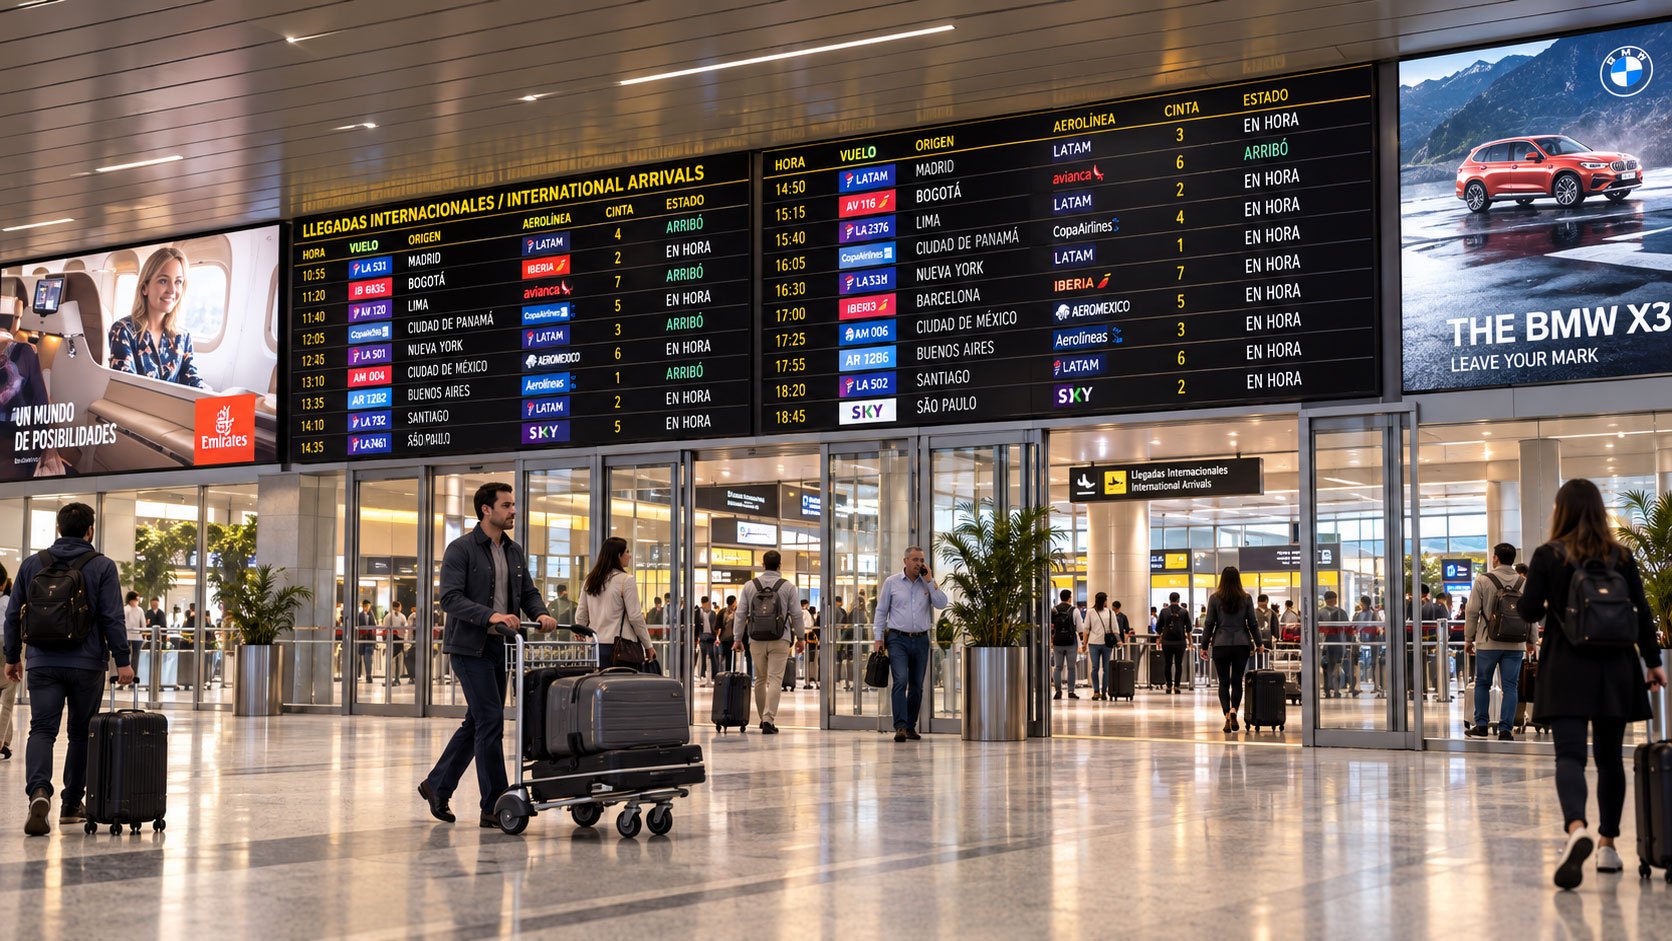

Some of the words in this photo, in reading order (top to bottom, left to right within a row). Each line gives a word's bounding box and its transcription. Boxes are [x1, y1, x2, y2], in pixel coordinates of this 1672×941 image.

[776, 156, 805, 170] HORA
[840, 146, 876, 161] VUELO
[916, 136, 953, 151] ORIGEN
[1165, 101, 1199, 116] CINTA
[1244, 89, 1288, 106] ESTADO
[777, 180, 805, 195] 14:50
[856, 171, 888, 185] LATAM
[916, 160, 954, 176] MADRID
[1054, 141, 1091, 157] LATAM
[1177, 128, 1183, 141] 3
[1245, 117, 1259, 132] EN
[1265, 112, 1299, 129] HORA
[303, 215, 367, 238] LLEGADAS
[370, 195, 494, 227] INTERNACIONALES
[498, 194, 503, 209] /
[508, 177, 624, 207] INTERNATIONAL
[628, 165, 704, 190] ARRIVALS
[776, 206, 805, 220] 15:15
[917, 181, 961, 202] BOGOTÁ
[1053, 171, 1091, 184] avianca
[1177, 155, 1184, 169] 6
[1244, 138, 1288, 160] ARRIBÓ
[776, 231, 805, 246] 15:40
[917, 214, 940, 229] LIMA
[1055, 195, 1091, 210] LATAM
[1177, 183, 1183, 196] 2
[1245, 173, 1260, 188] EN
[1266, 168, 1299, 185] HORA
[303, 248, 325, 259] HORA
[350, 240, 378, 253] VUELO
[408, 231, 441, 245] ORIGEN
[606, 204, 633, 217] CINTA
[667, 195, 704, 209] ESTADO
[303, 268, 325, 281] 10:55
[409, 252, 440, 267] MADRID
[536, 237, 563, 250] LATAM
[615, 228, 621, 239] 4
[666, 213, 703, 233] ARRIBÓ
[776, 257, 805, 271] 16:05
[917, 238, 954, 255] CIUDAD
[959, 236, 971, 249] DE
[976, 227, 1019, 247] PANAMÁ
[1054, 221, 1112, 238] CopaAirlines
[1176, 210, 1184, 223] 4
[1245, 201, 1260, 216] EN
[1266, 197, 1300, 214] HORA
[303, 290, 325, 302] 11:20
[409, 271, 445, 289] BOGOTÁ
[528, 262, 554, 273] IBERIA
[615, 252, 621, 264] 2
[667, 245, 679, 257] EN
[683, 241, 711, 255] HORA
[776, 282, 805, 296] 16:30
[917, 265, 951, 281] NUEVA
[955, 261, 983, 276] YORK
[1055, 249, 1093, 264] LATAM
[1178, 238, 1182, 252] 1
[1246, 230, 1260, 244] EN
[1266, 225, 1300, 242] HORA
[776, 307, 805, 322] 17:00
[917, 288, 980, 307] BARCELONA
[1055, 277, 1094, 291] IBERIA
[1177, 266, 1184, 280] 7
[1246, 258, 1261, 273] EN
[1267, 254, 1300, 271] HORA
[303, 311, 325, 323] 11:40
[409, 299, 428, 311] LIMA
[524, 286, 560, 298] avianca
[615, 276, 621, 287] 7
[666, 263, 703, 282] ARRIBÓ
[303, 333, 324, 345] 12:05
[408, 320, 439, 333] CIUDAD
[442, 318, 453, 330] DE
[457, 311, 493, 328] PANAMÁ
[615, 299, 620, 311] 5
[667, 294, 679, 306] EN
[683, 290, 711, 304] HORA
[776, 333, 805, 347] 17:25
[855, 328, 868, 338] AM
[871, 326, 888, 337] 006
[917, 318, 954, 333] CIUDAD
[959, 315, 972, 329] DE
[977, 310, 1016, 327] MÉXICO
[1072, 300, 1130, 317] AEROMEXICO
[1178, 294, 1184, 308] 5
[1246, 287, 1261, 302] EN
[1267, 283, 1300, 299] HORA
[408, 343, 436, 355] NUEVA
[440, 340, 463, 352] YORK
[536, 330, 563, 342] LATAM
[615, 324, 620, 335] 3
[666, 312, 703, 330] ARRIBÓ
[776, 358, 805, 372] 17:55
[846, 355, 860, 366] AR
[917, 344, 959, 360] BUENOS
[964, 341, 994, 355] AIRES
[1178, 322, 1184, 336] 3
[1247, 316, 1261, 331] EN
[1267, 312, 1301, 329] HORA
[1447, 315, 1515, 347] THE
[1526, 305, 1617, 342] BMW
[1627, 302, 1671, 334] X3
[303, 376, 324, 387] 13:10
[408, 365, 438, 378] CIUDAD
[442, 363, 452, 375] DE
[456, 360, 487, 373] MÉXICO
[615, 347, 621, 359] 6
[667, 343, 679, 355] EN
[683, 340, 710, 353] HORA
[408, 387, 441, 400] BUENOS
[445, 384, 470, 397] AIRES
[616, 372, 619, 383] 1
[666, 362, 703, 379] ARRIBÓ
[776, 384, 805, 397] 18:20
[917, 370, 969, 386] SANTIAGO
[1063, 359, 1098, 372] LATAM
[1178, 351, 1185, 365] 6
[1247, 345, 1262, 359] EN
[1268, 341, 1301, 358] HORA
[1451, 355, 1499, 372] LEAVE
[1504, 352, 1547, 368] YOUR
[1552, 348, 1598, 365] MARK
[34, 402, 74, 424] MUNDO
[302, 419, 324, 431] 14:10
[408, 410, 448, 424] SANTIAGO
[536, 401, 563, 413] LATAM
[615, 396, 620, 408] 2
[667, 392, 678, 404] EN
[683, 390, 711, 403] HORA
[776, 410, 805, 423] 18:45
[852, 404, 883, 420] SKY
[1059, 387, 1092, 403] SKY
[1178, 380, 1185, 394] 2
[1248, 374, 1262, 389] EN
[1268, 371, 1302, 387] HORA
[15, 431, 29, 451] DE
[33, 423, 116, 449] POSIBILIDADES
[202, 434, 247, 449] Emirates
[530, 425, 558, 439] SKY
[615, 421, 620, 432] 5
[667, 417, 678, 429] EN
[683, 415, 711, 428] HORA
[1132, 469, 1165, 481] Llegadas
[1168, 466, 1228, 477] Internacionales
[1132, 481, 1180, 491] International
[1182, 479, 1211, 488] Arrivals
